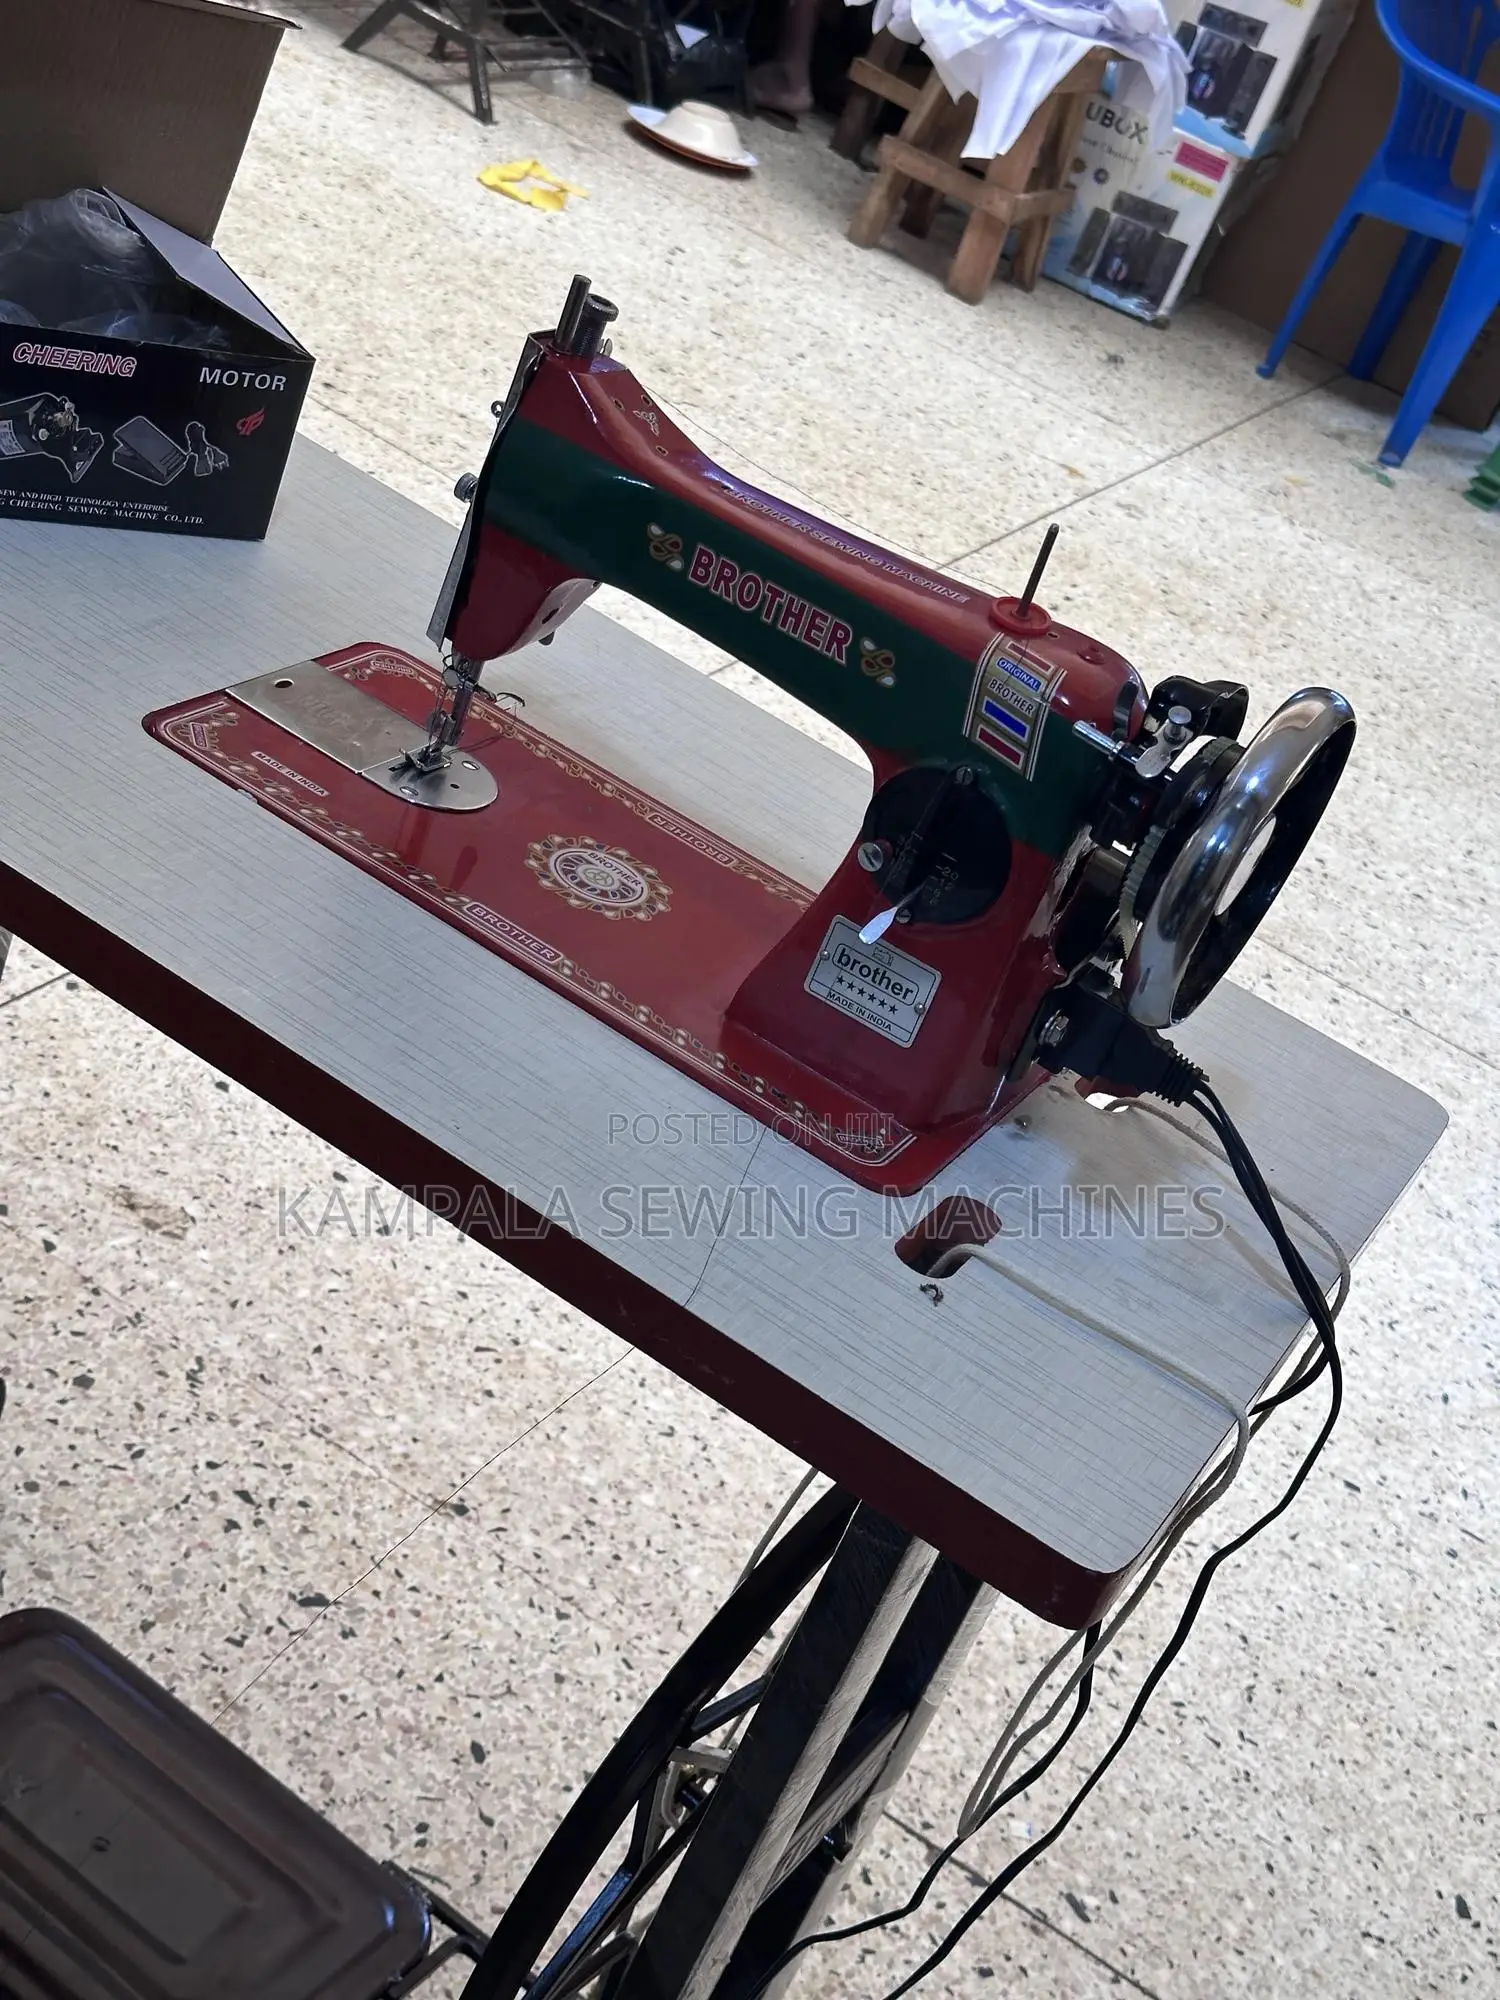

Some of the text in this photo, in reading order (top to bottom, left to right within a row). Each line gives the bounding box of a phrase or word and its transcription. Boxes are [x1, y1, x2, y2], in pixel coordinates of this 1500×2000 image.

[13, 342, 137, 377] CHEERING
[200, 367, 287, 391] MOTOR
[10, 498, 62, 511] CHEERING
[68, 504, 107, 516] SEWING
[114, 509, 159, 521] MACHINE
[184, 515, 204, 525] LTD.
[19, 491, 38, 499] AND
[40, 493, 62, 502] HIGH
[65, 495, 119, 508] TECHNOLOGY
[122, 501, 170, 512] ENTERPRISE
[723, 487, 970, 604] BROTHER SEWING MACHINE
[687, 543, 853, 667] BROTHER
[999, 659, 1039, 690] ORIGINAL
[988, 677, 1035, 716] BROTHER
[256, 753, 326, 795] MADE IN INDIA
[653, 816, 729, 862] BROTHER
[587, 852, 641, 887] BROTHER
[472, 906, 555, 959] BROTHER
[837, 948, 913, 1001] brother
[826, 991, 892, 1031] MADE IN INDIA
